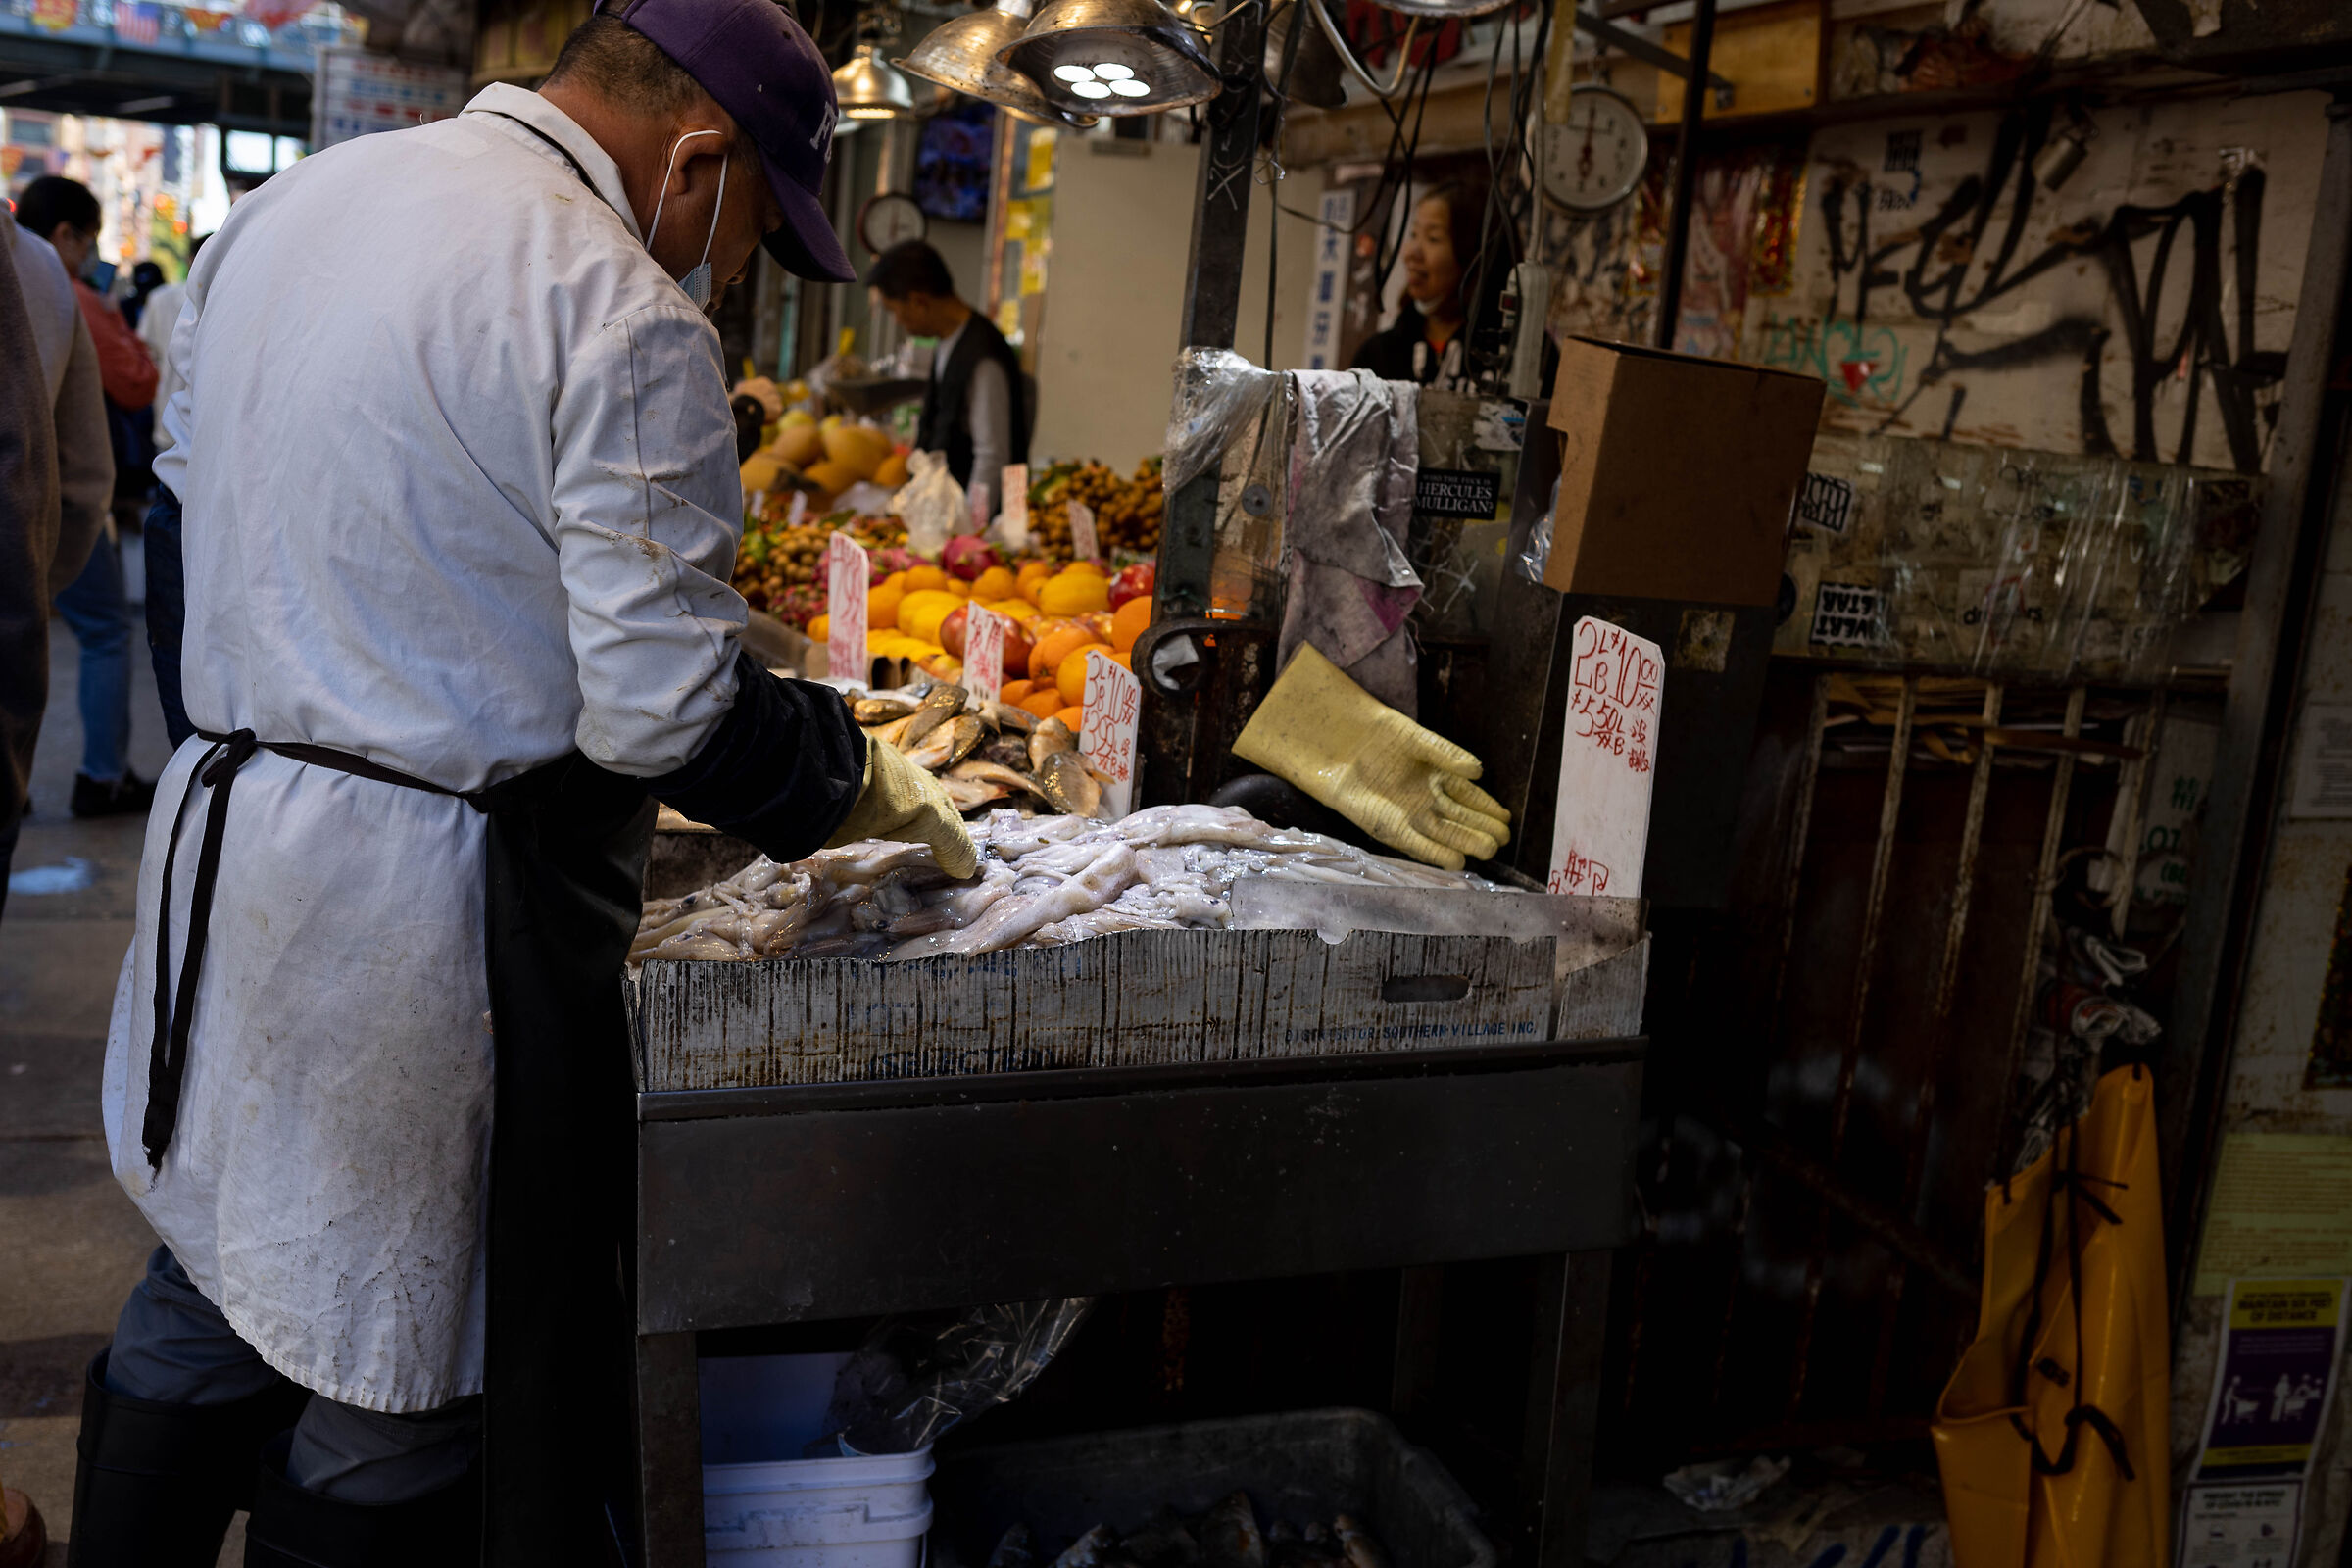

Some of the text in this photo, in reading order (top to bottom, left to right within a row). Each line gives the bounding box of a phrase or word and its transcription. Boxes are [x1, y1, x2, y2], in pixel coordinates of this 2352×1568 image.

[1418, 480, 1494, 499] HERCULES
[1414, 495, 1494, 514] MULLIGAN?
[1383, 1024, 1446, 1039] SOUTHERN
[1451, 1022, 1505, 1036] VILLAGE
[1512, 1021, 1537, 1035] INC.
